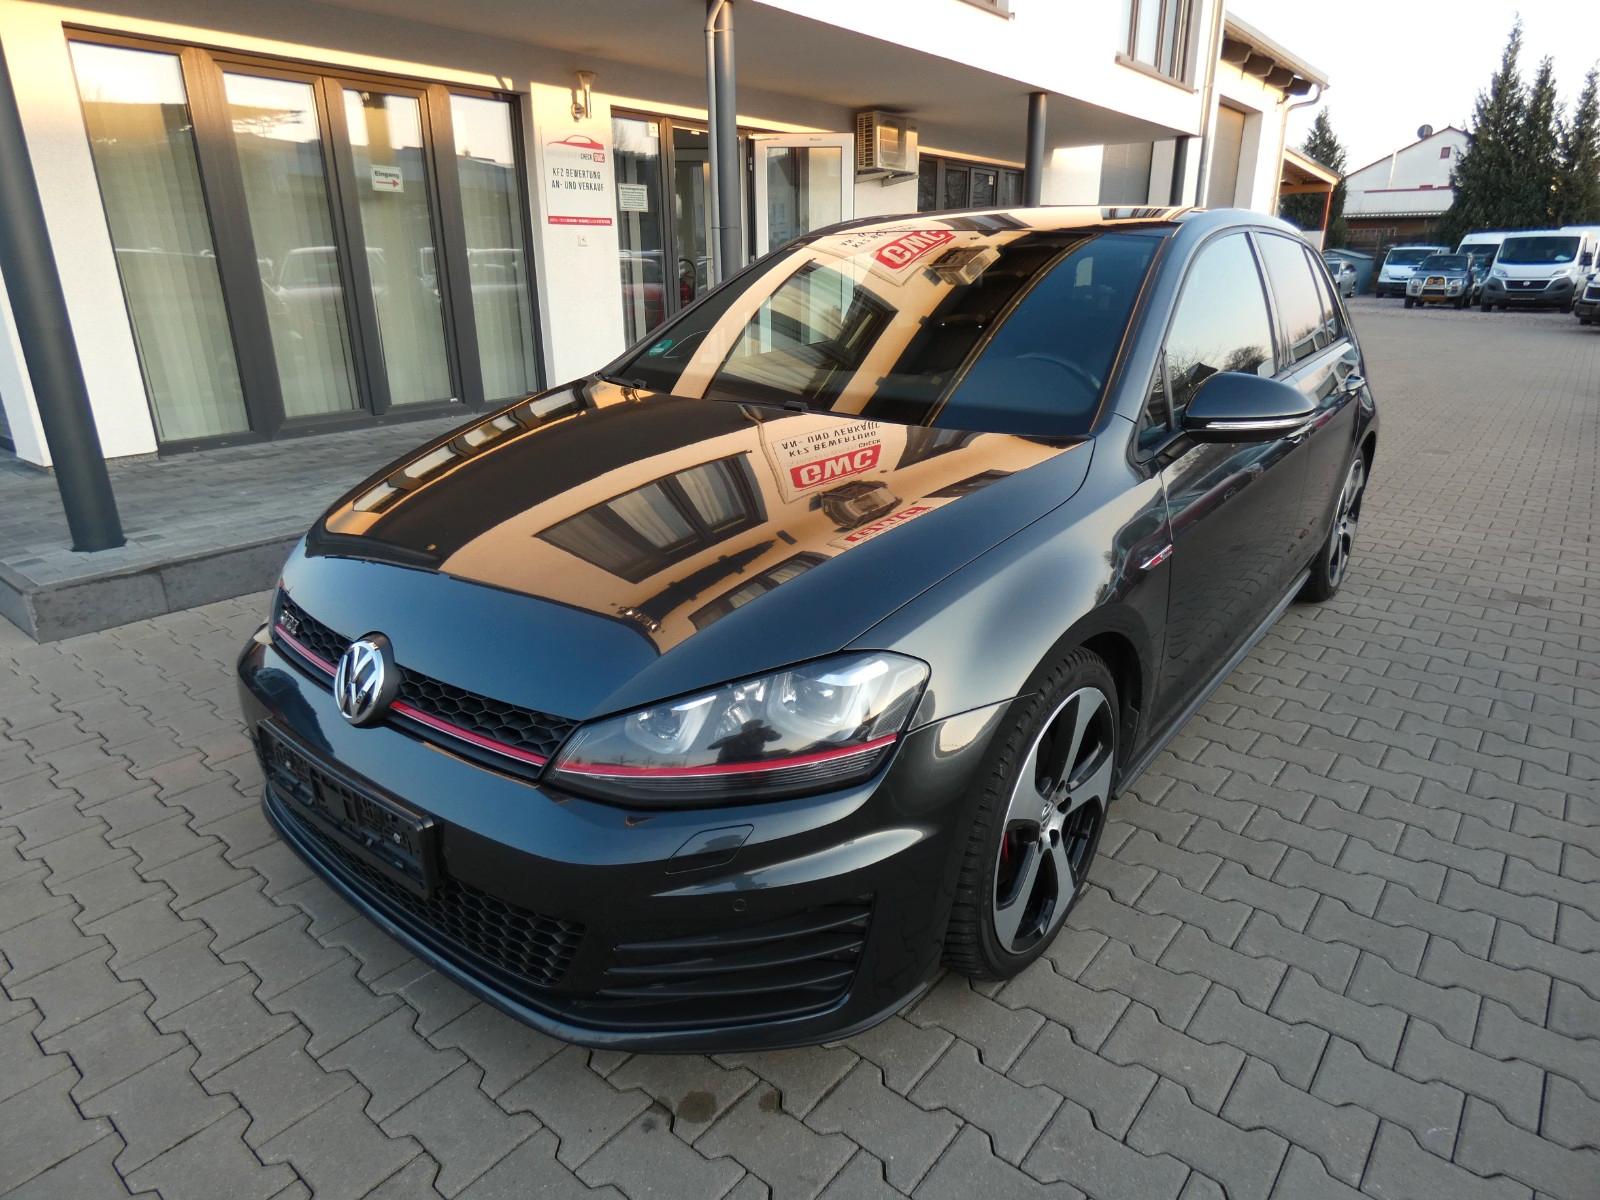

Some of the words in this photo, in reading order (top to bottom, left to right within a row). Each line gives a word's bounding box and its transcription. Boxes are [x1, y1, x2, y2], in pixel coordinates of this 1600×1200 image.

[565, 168, 601, 180] BEWERTUNG
[552, 180, 562, 188] AN-
[564, 181, 577, 190] UND
[578, 182, 604, 192] VERKAUF
